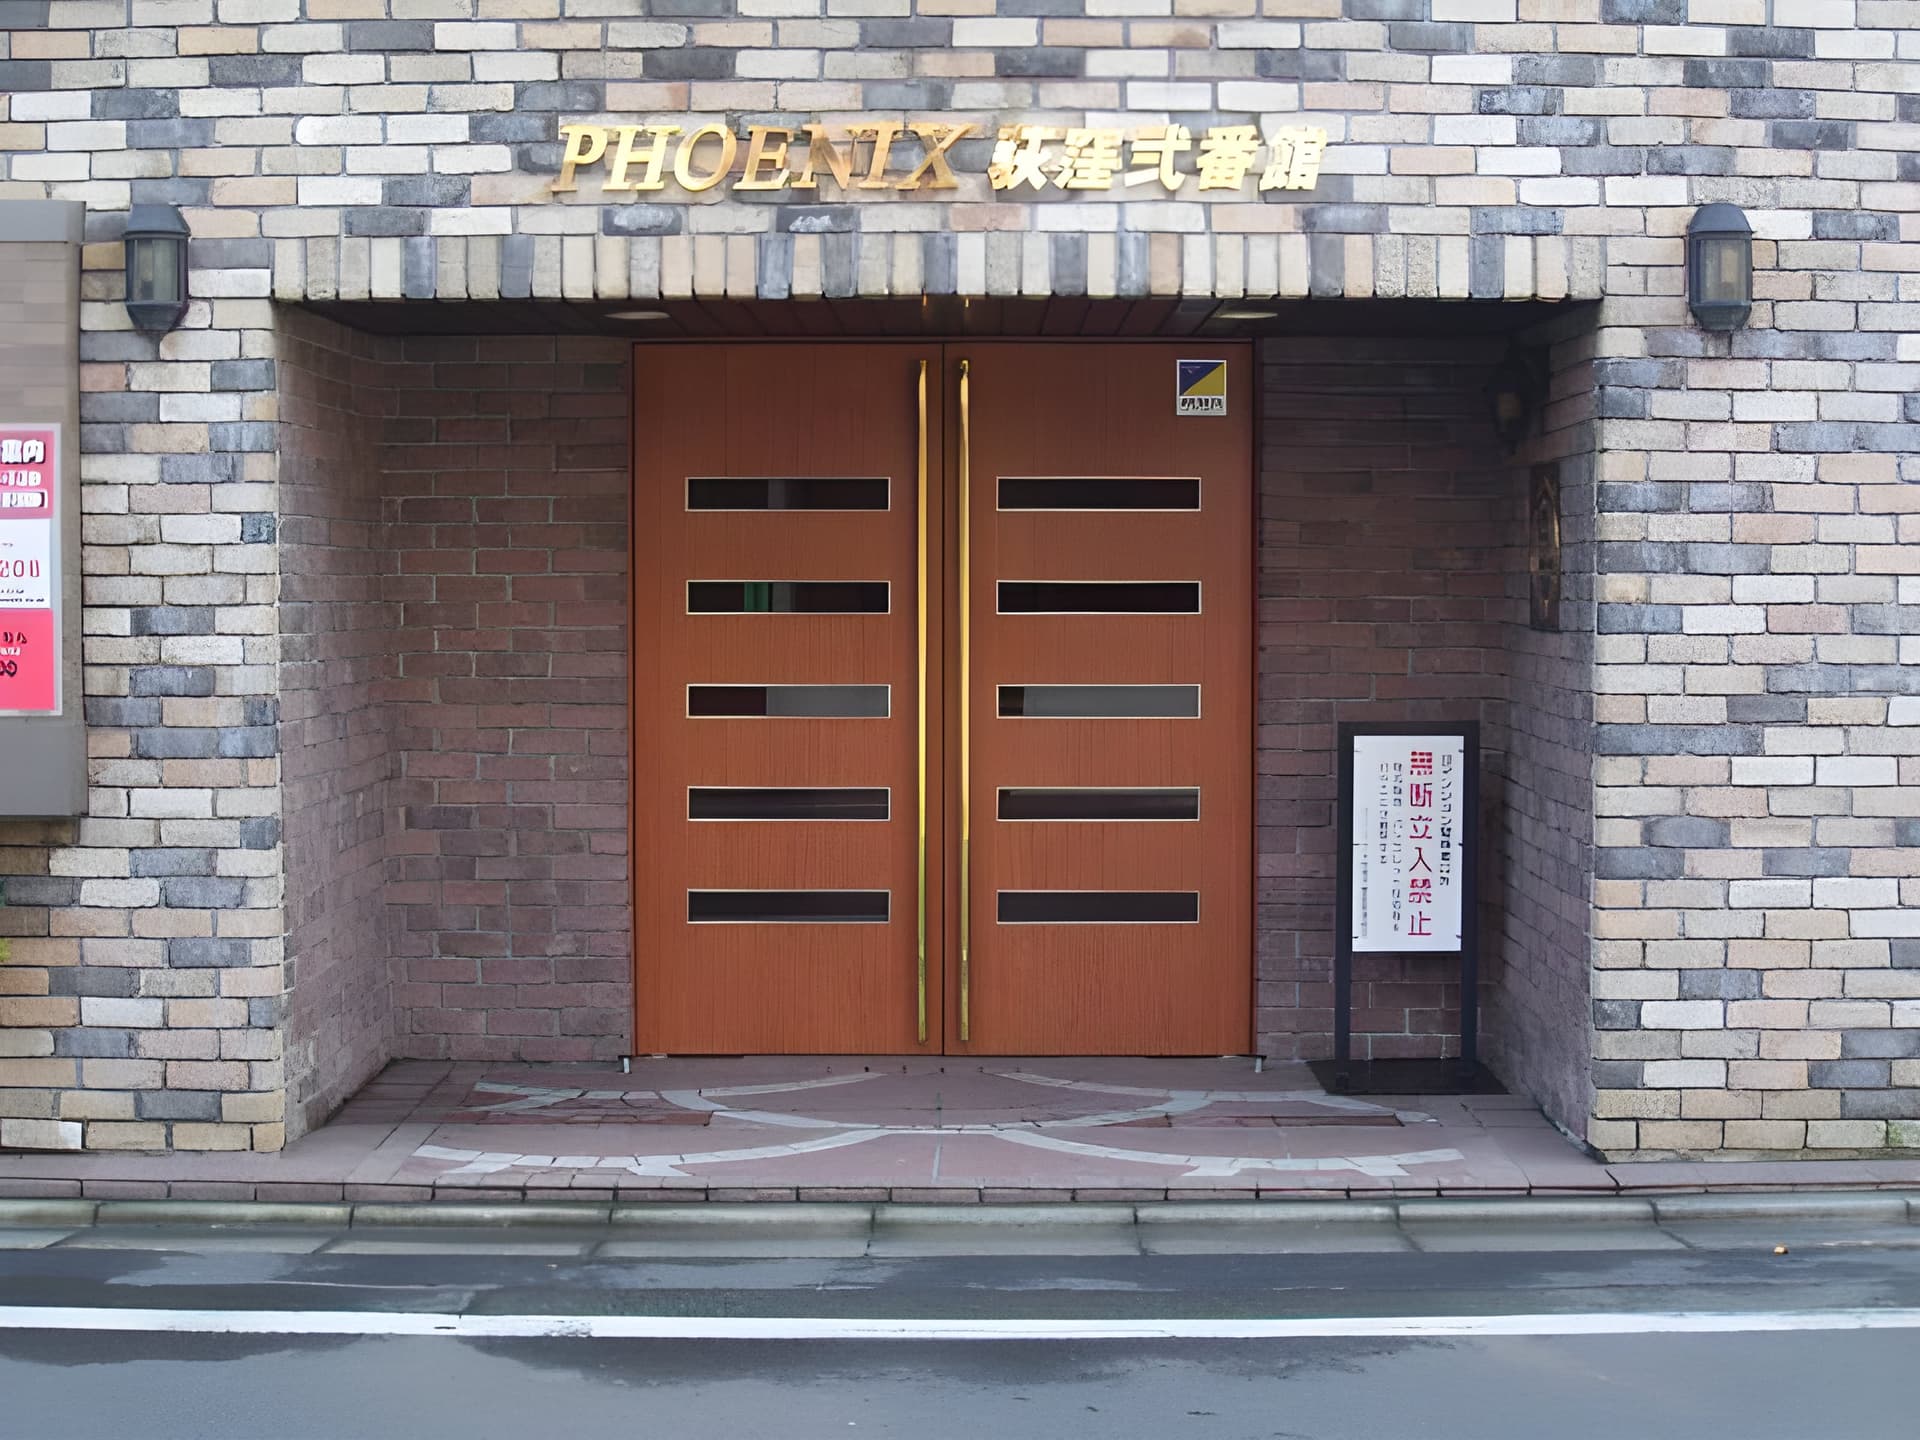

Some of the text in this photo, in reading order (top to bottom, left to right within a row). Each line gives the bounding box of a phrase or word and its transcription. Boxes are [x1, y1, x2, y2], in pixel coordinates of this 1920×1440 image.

[551, 122, 978, 192] PHOENIX
[1408, 751, 1433, 936] 無断立入禁止
